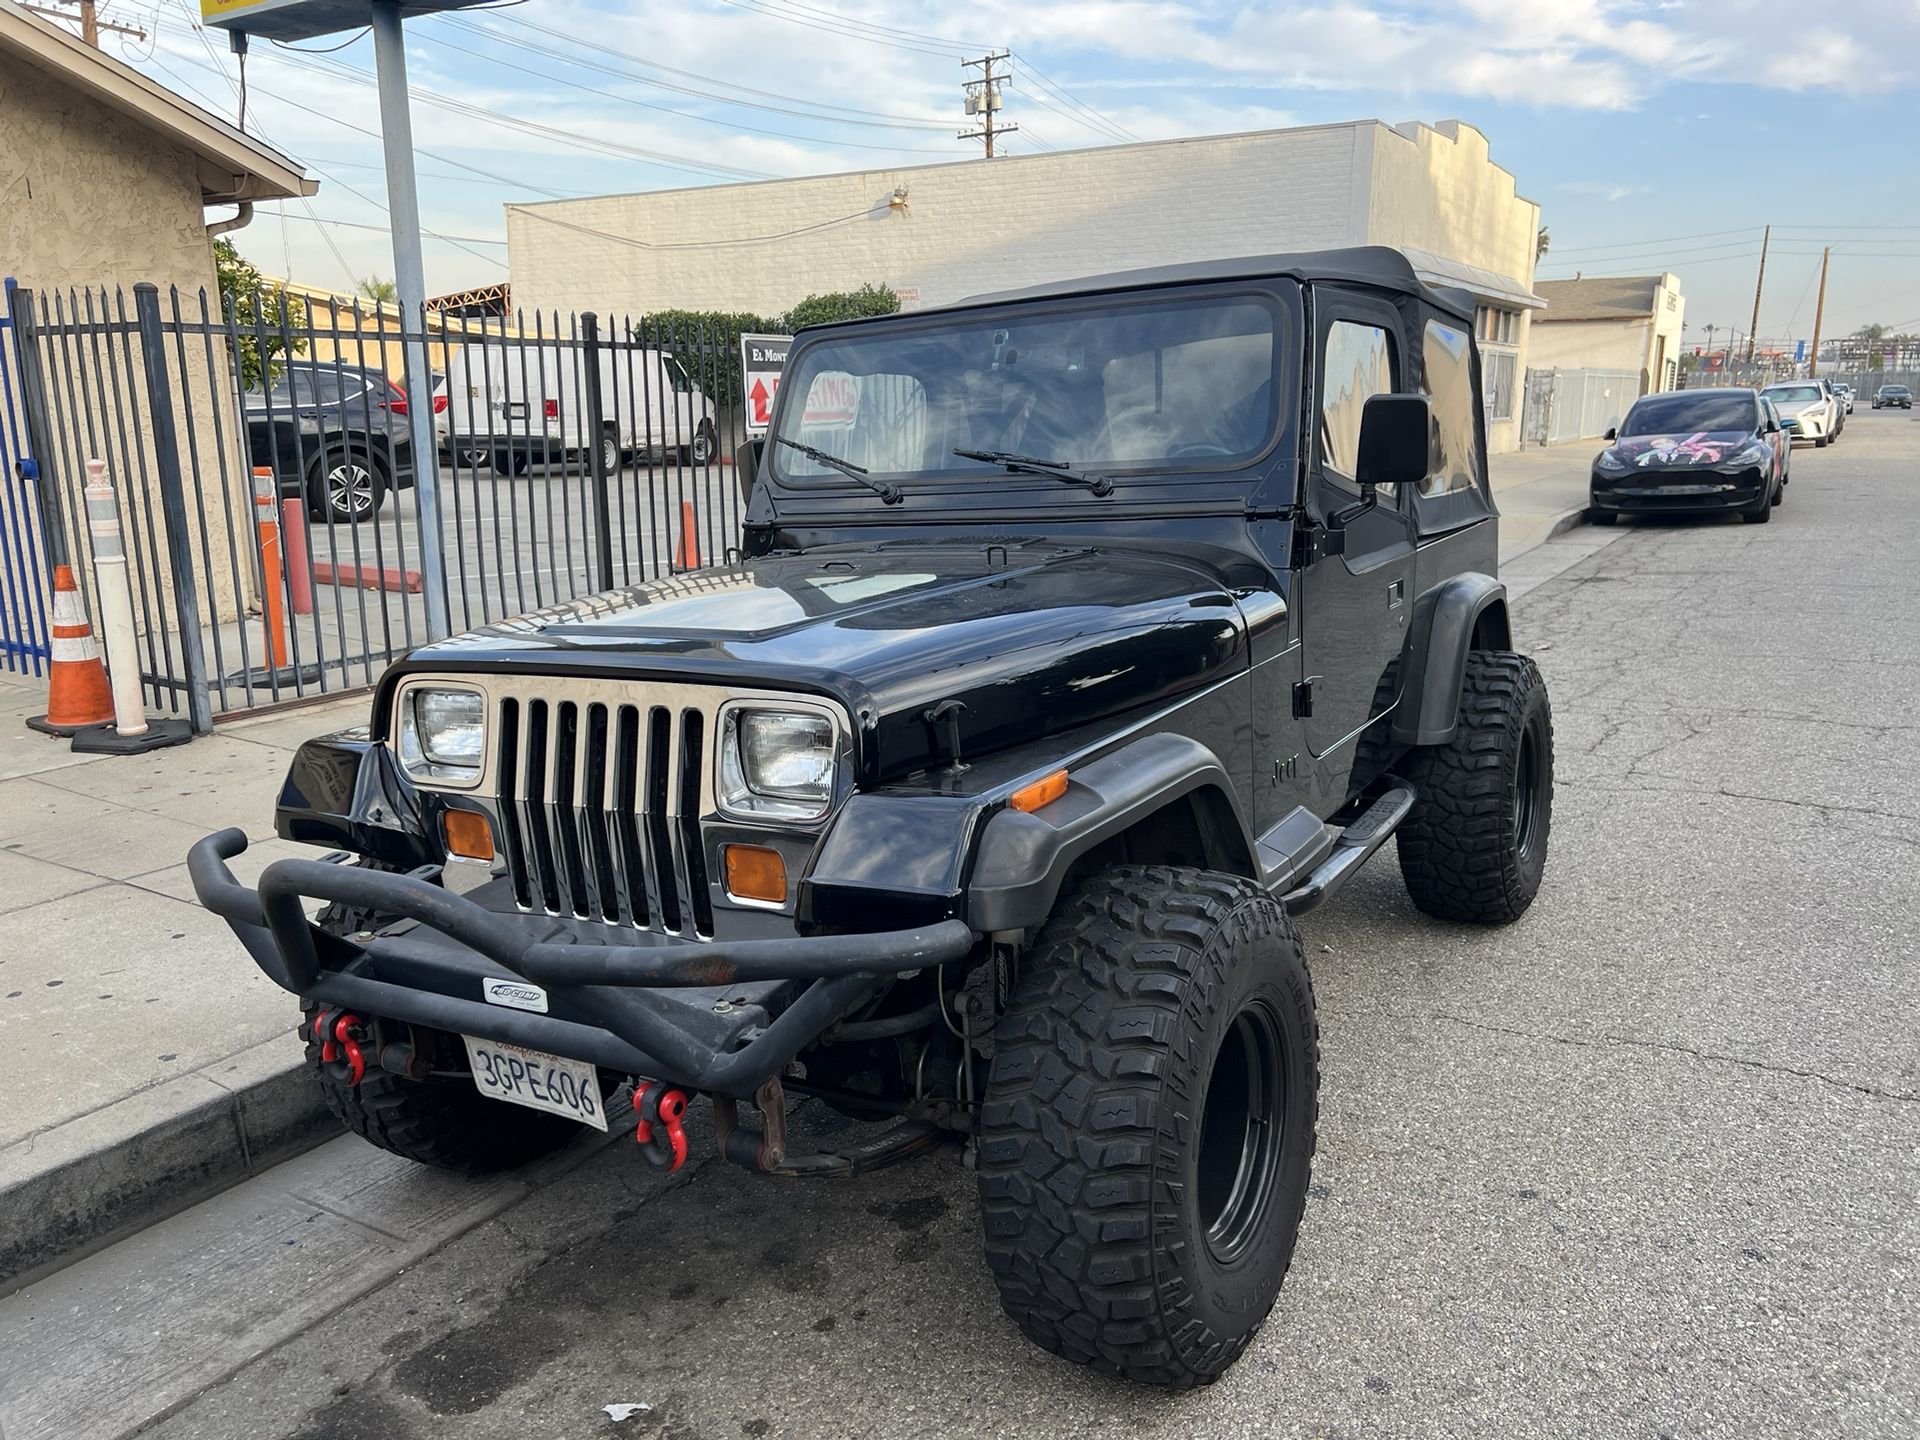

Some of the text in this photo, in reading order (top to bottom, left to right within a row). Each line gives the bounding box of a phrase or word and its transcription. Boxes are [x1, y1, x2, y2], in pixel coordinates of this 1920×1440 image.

[764, 348, 788, 362] MONT
[511, 988, 542, 1001] COMP
[477, 1050, 596, 1116] 3GPE606
